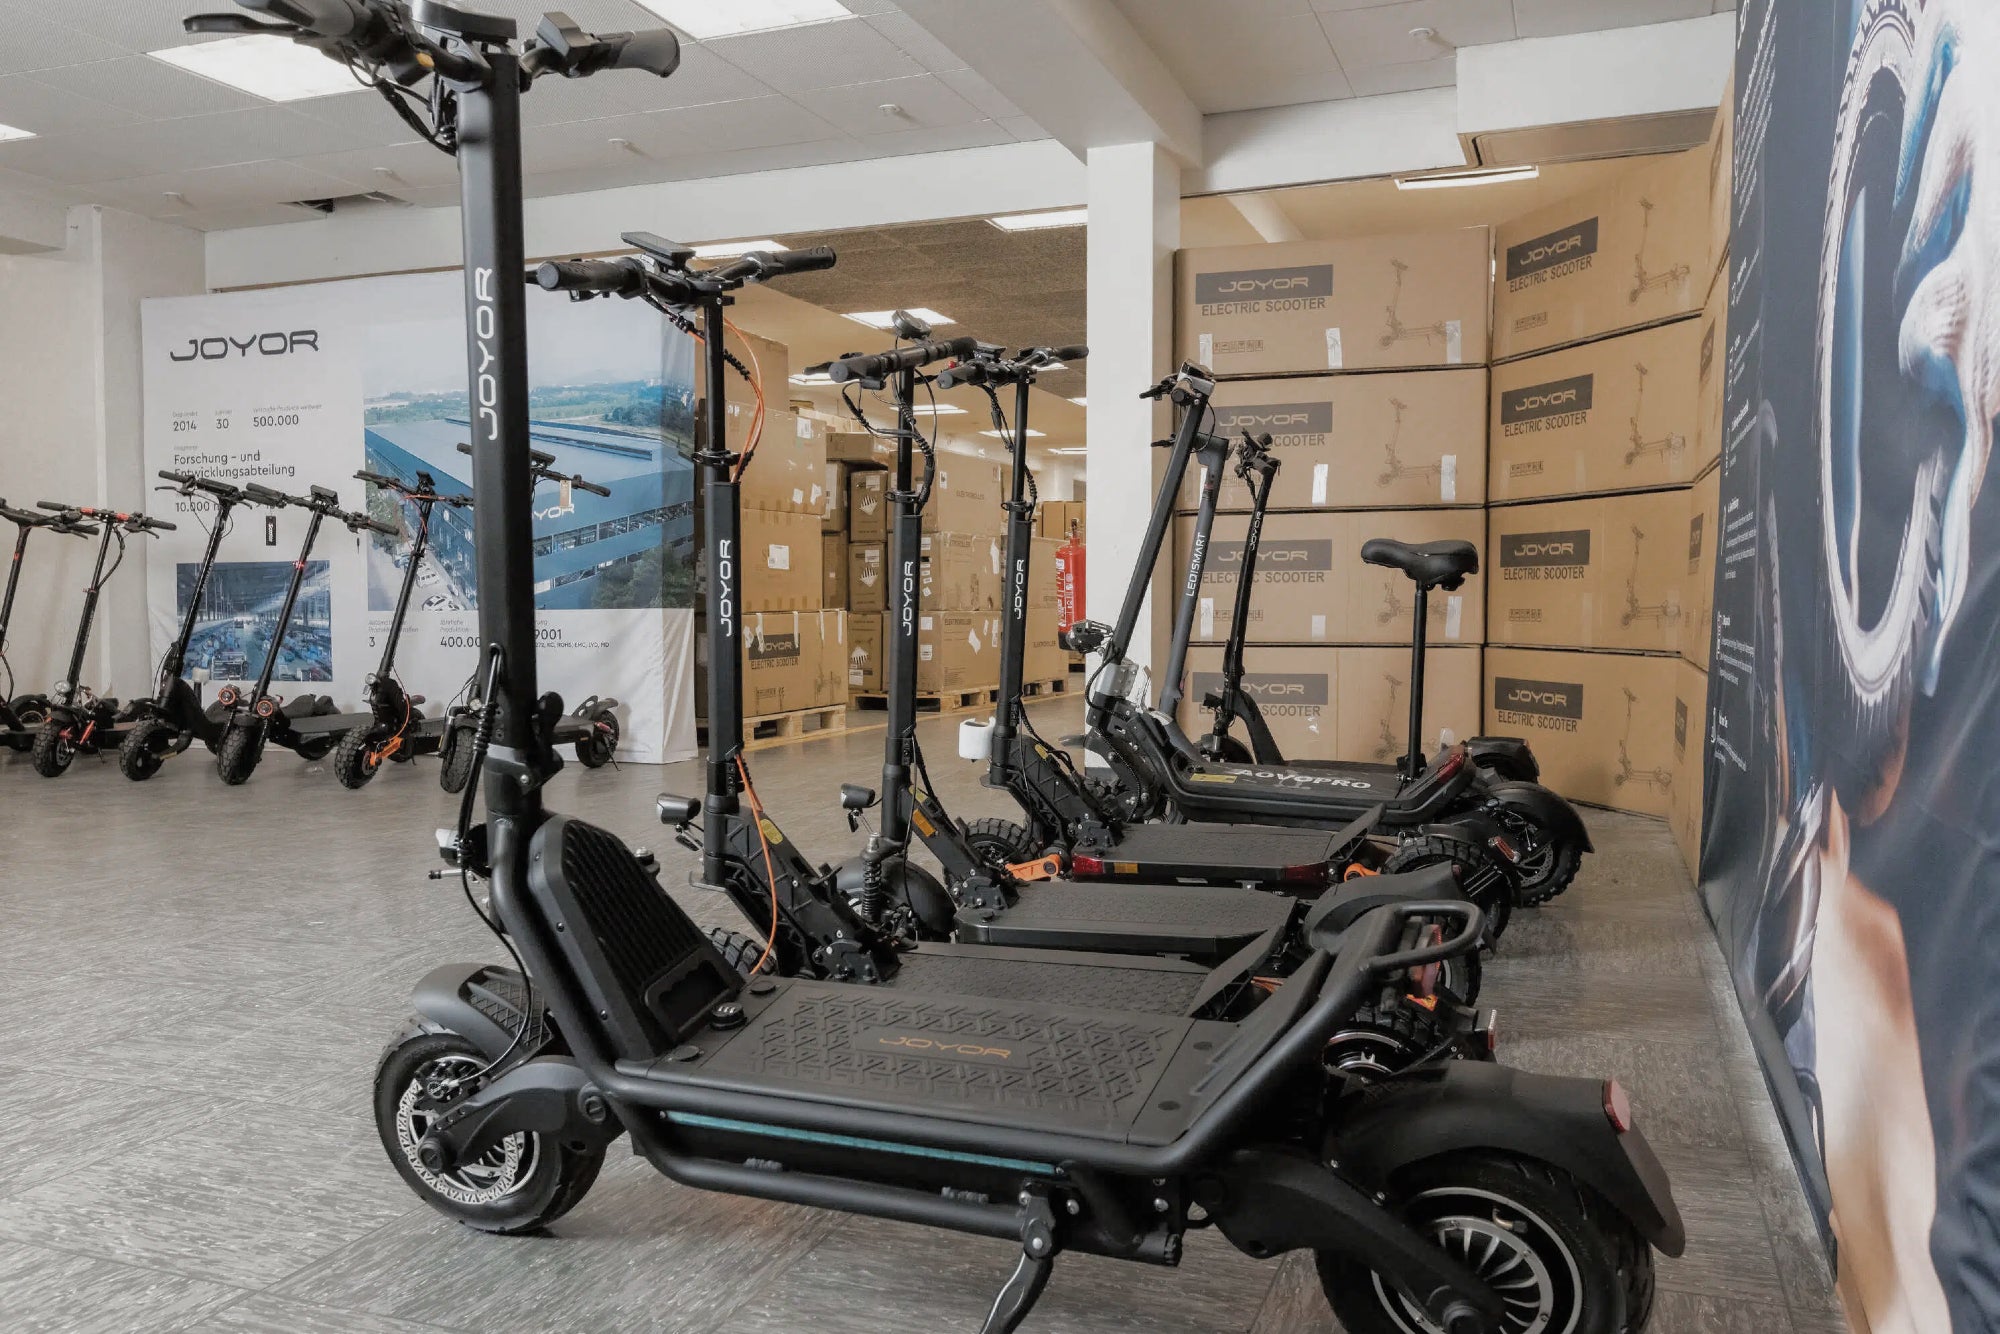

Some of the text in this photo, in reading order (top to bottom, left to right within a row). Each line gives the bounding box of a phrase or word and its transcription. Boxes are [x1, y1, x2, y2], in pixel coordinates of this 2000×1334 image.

[1520, 234, 1582, 266] JOYOR
[1509, 255, 1593, 293] ELECTRIC SCOOTER
[1218, 276, 1309, 293] JOYOR
[1201, 297, 1325, 316] ELECTRIC SCOOTER
[170, 329, 319, 361] JOYOR
[475, 266, 498, 440] JOYOR
[1515, 389, 1577, 412] JOYOR
[173, 421, 197, 432] 2014
[216, 418, 229, 429] 30
[253, 414, 299, 427] 500.000
[1219, 413, 1309, 427] JOYOR
[1504, 411, 1587, 438] ELECTRIC SCOOTER
[1273, 434, 1325, 447] COOTER
[174, 452, 228, 466] Forschung
[240, 450, 260, 462] und
[1250, 511, 1262, 551] JOYOR
[1514, 542, 1575, 557] JOYOR
[1202, 571, 1325, 584] ELECTC SCOOTER
[1503, 566, 1584, 581] ELECTRIC SCOOTER
[720, 539, 732, 637] JOYOR
[1014, 559, 1024, 620] JOYOR
[902, 561, 914, 636] JOYOR
[368, 636, 376, 647] 3
[440, 636, 480, 647] 400.00
[764, 641, 792, 651] OYOR
[1508, 689, 1568, 707] JOYOR
[1262, 705, 1320, 717] SCOOTER
[1498, 710, 1578, 733] ELECTRIC SCOOTER
[879, 1036, 1011, 1059] JOYOR
